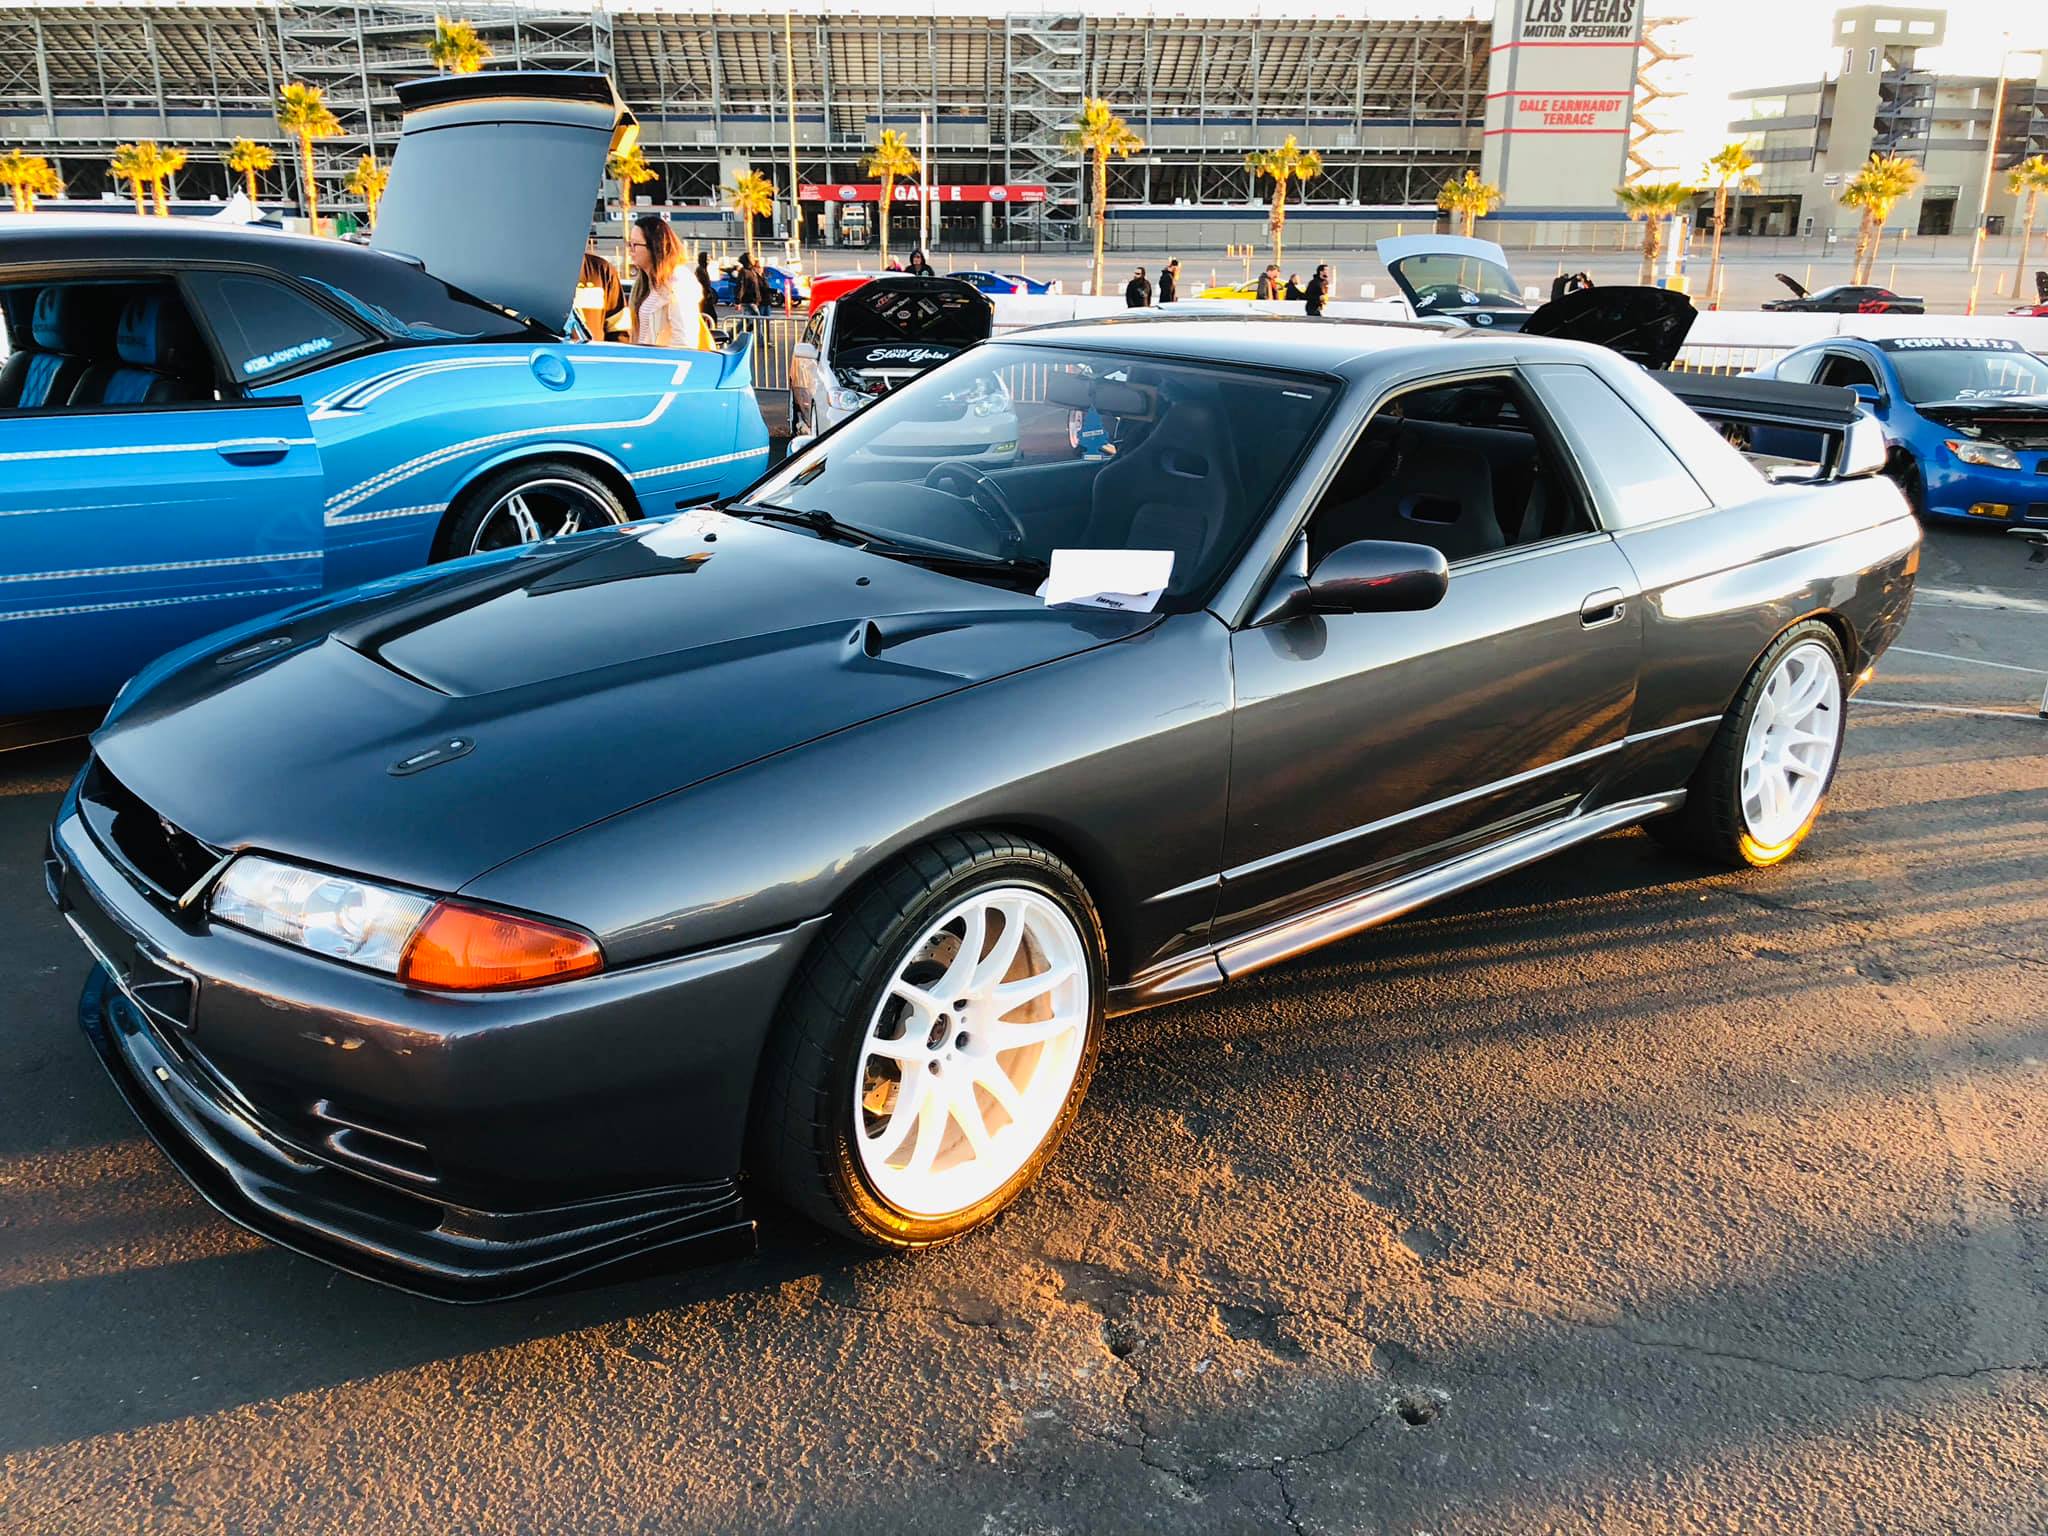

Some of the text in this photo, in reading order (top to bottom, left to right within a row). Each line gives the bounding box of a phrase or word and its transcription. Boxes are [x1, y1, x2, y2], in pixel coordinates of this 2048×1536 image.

[1525, 0, 1635, 23] LAS VEGAS
[1523, 25, 1633, 38] MOTOR SPEEDWAY
[1519, 99, 1622, 112] DALE EARNHARDT
[1543, 113, 1596, 125] TERRACE
[951, 186, 962, 201] E
[1893, 338, 1944, 349] SCION
